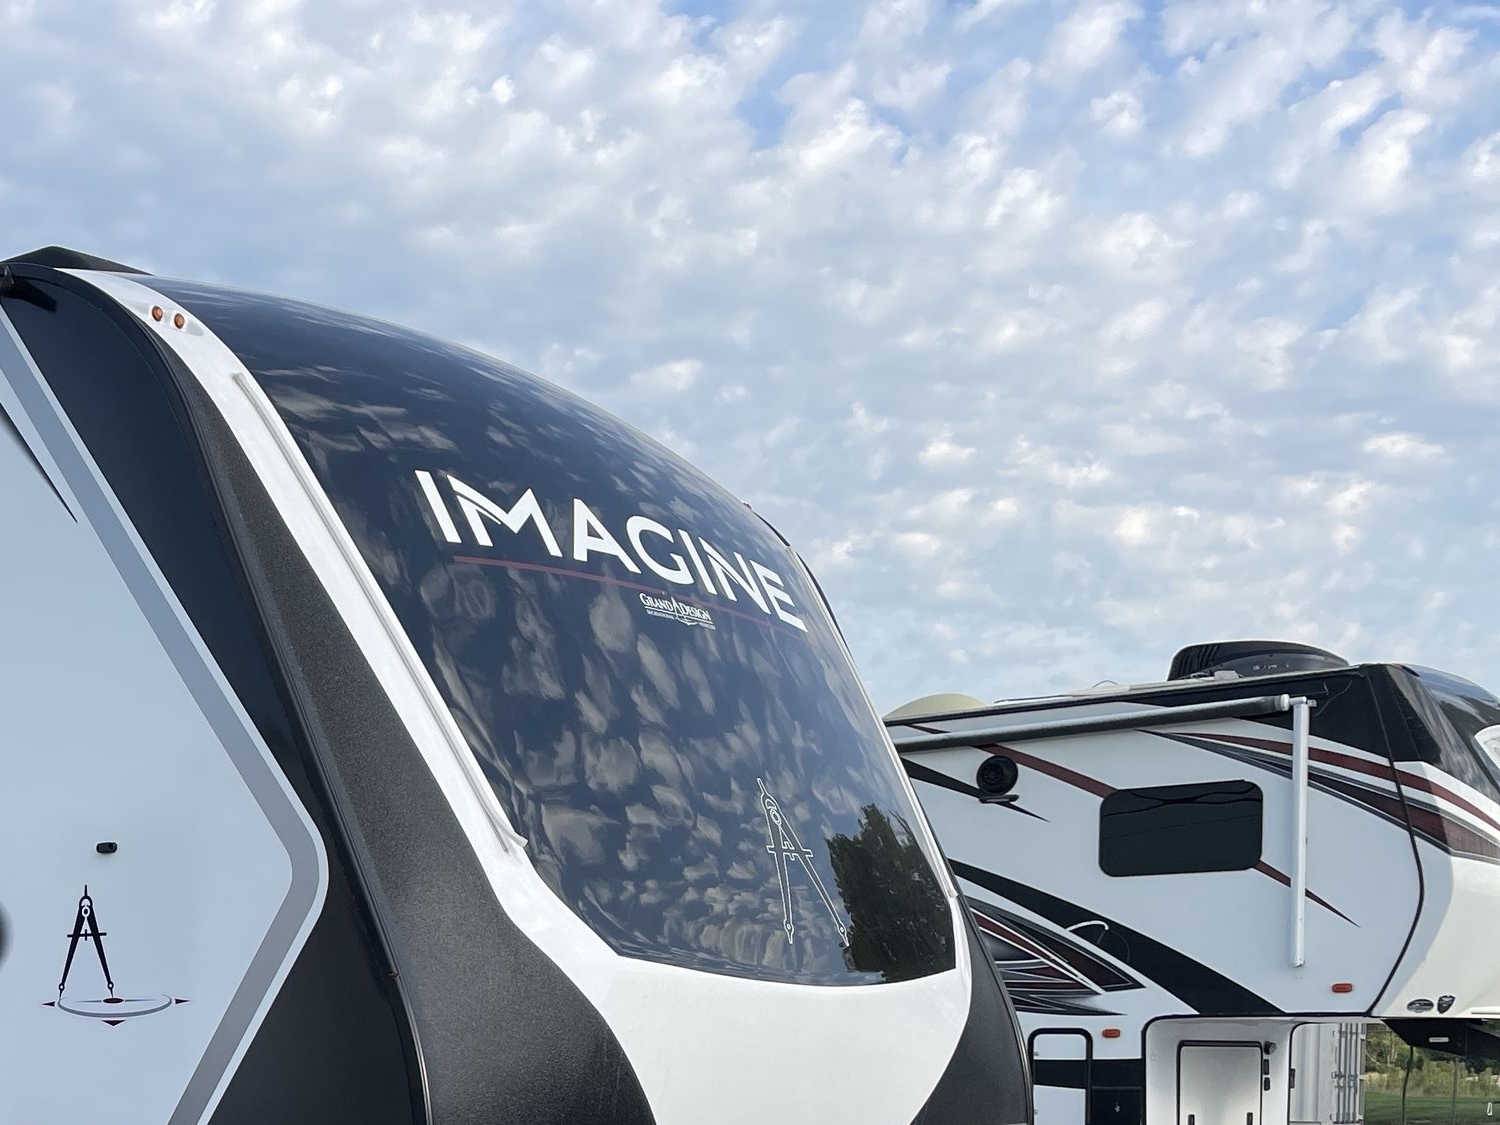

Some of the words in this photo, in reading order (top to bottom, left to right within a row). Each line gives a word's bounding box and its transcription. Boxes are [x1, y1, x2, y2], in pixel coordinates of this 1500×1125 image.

[414, 468, 808, 633] IMAGINE
[639, 592, 674, 612] GRAND
[678, 602, 712, 621] DESIGN
